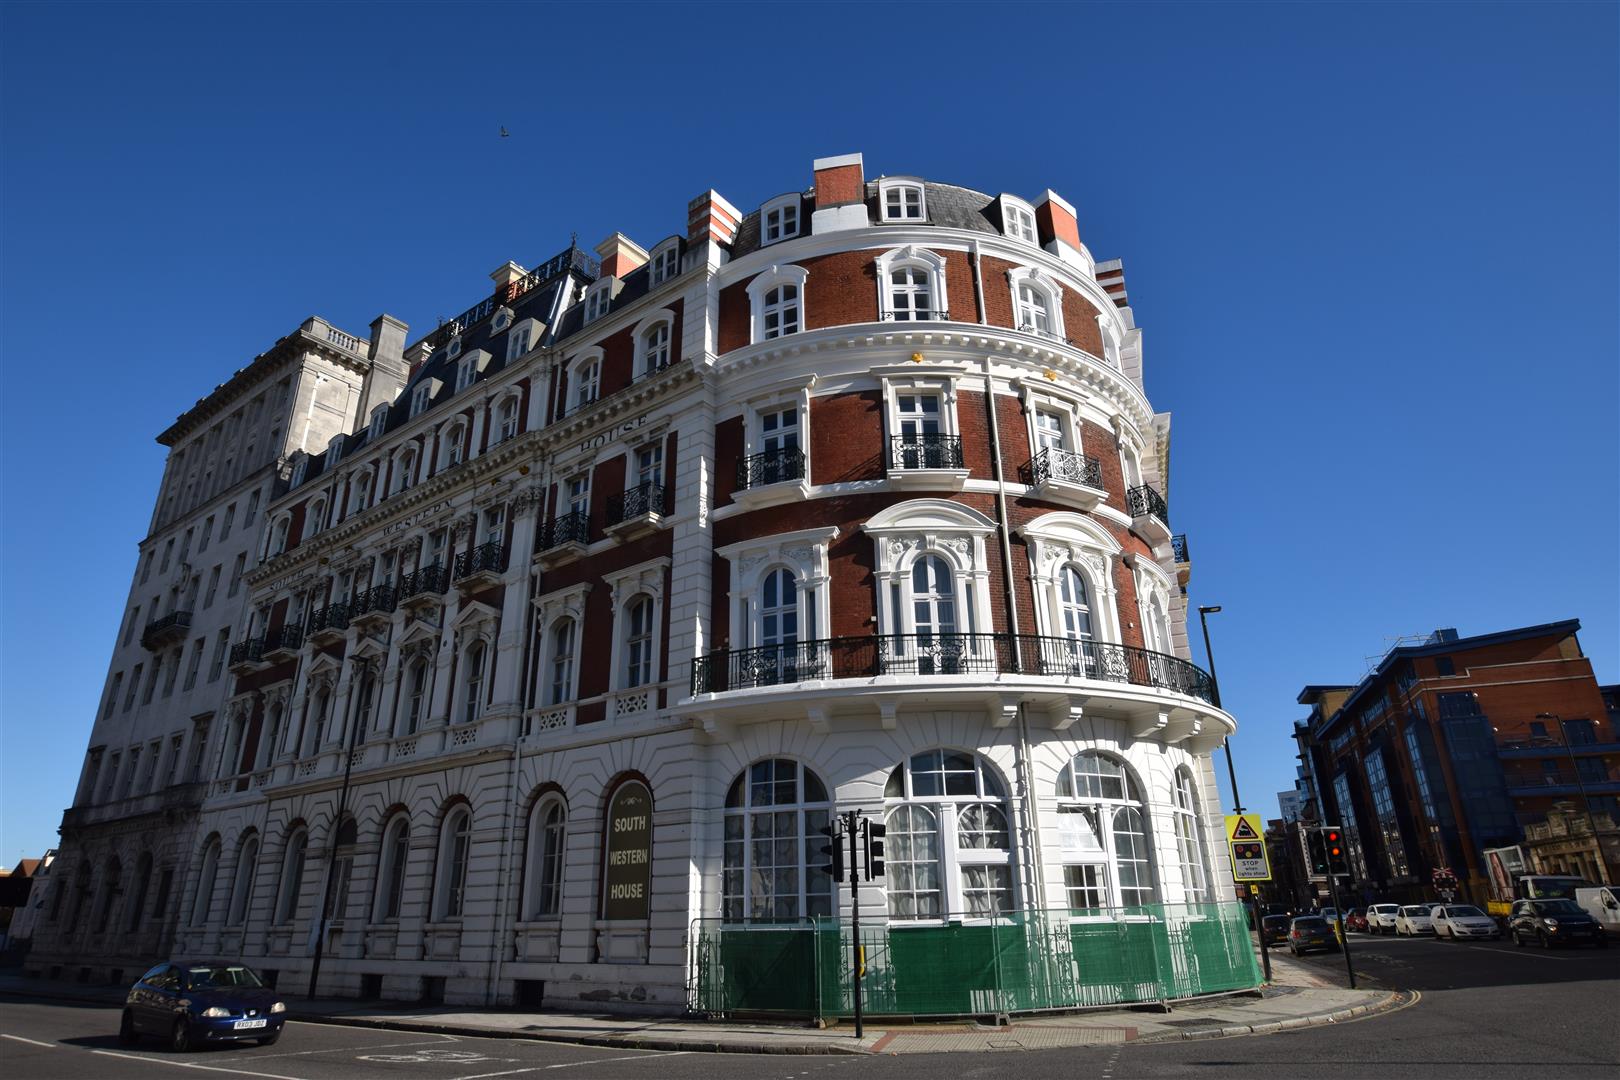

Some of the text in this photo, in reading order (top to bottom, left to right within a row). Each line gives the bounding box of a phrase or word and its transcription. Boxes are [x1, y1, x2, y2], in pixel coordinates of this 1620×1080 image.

[580, 415, 649, 452] HOUSE
[614, 815, 646, 833] SOUTH
[609, 848, 648, 866] WESTERN
[610, 883, 643, 900] HOUSE
